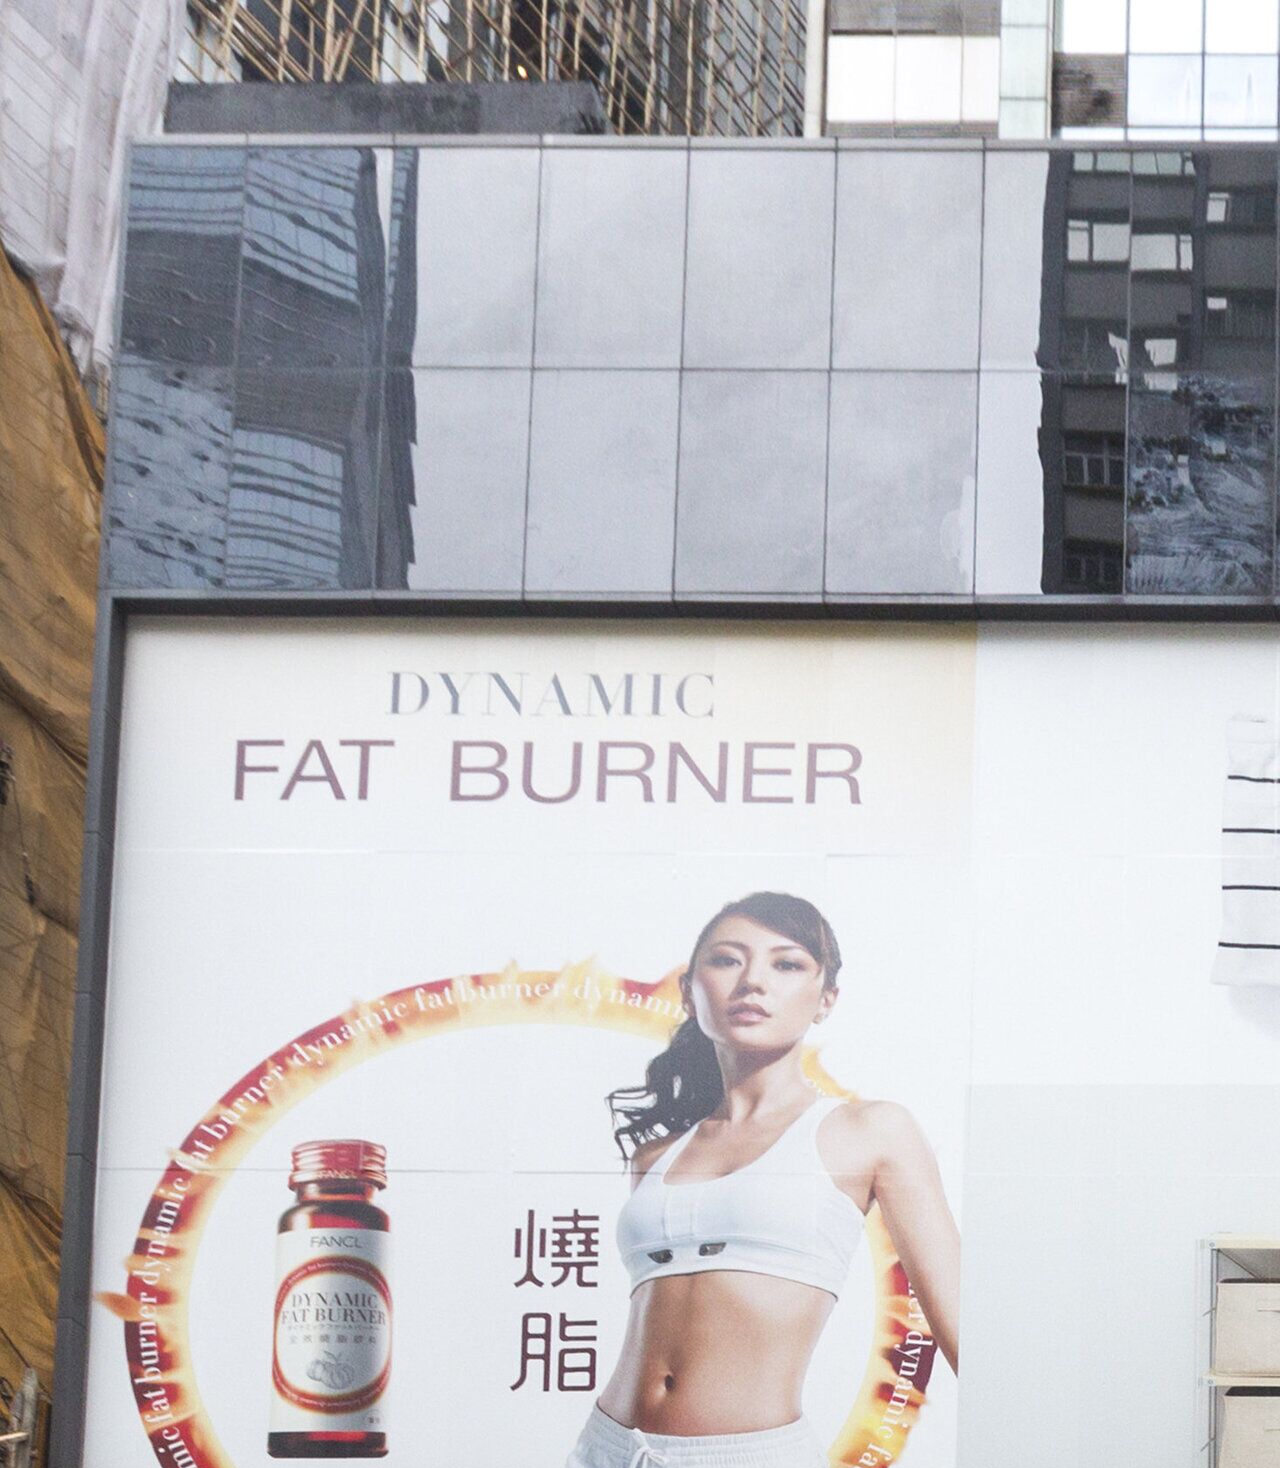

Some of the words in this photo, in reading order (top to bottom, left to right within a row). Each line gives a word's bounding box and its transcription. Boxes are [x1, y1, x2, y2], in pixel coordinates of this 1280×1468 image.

[384, 670, 715, 719] DYNAMIC
[232, 738, 396, 801] FAT
[448, 740, 864, 805] BURNER
[309, 1235, 363, 1249] FANCL
[281, 1308, 310, 1324] FAT
[314, 1309, 387, 1326] BURNER
[292, 1292, 378, 1310] DYNAMIC
[510, 1208, 600, 1393] 燒脂
